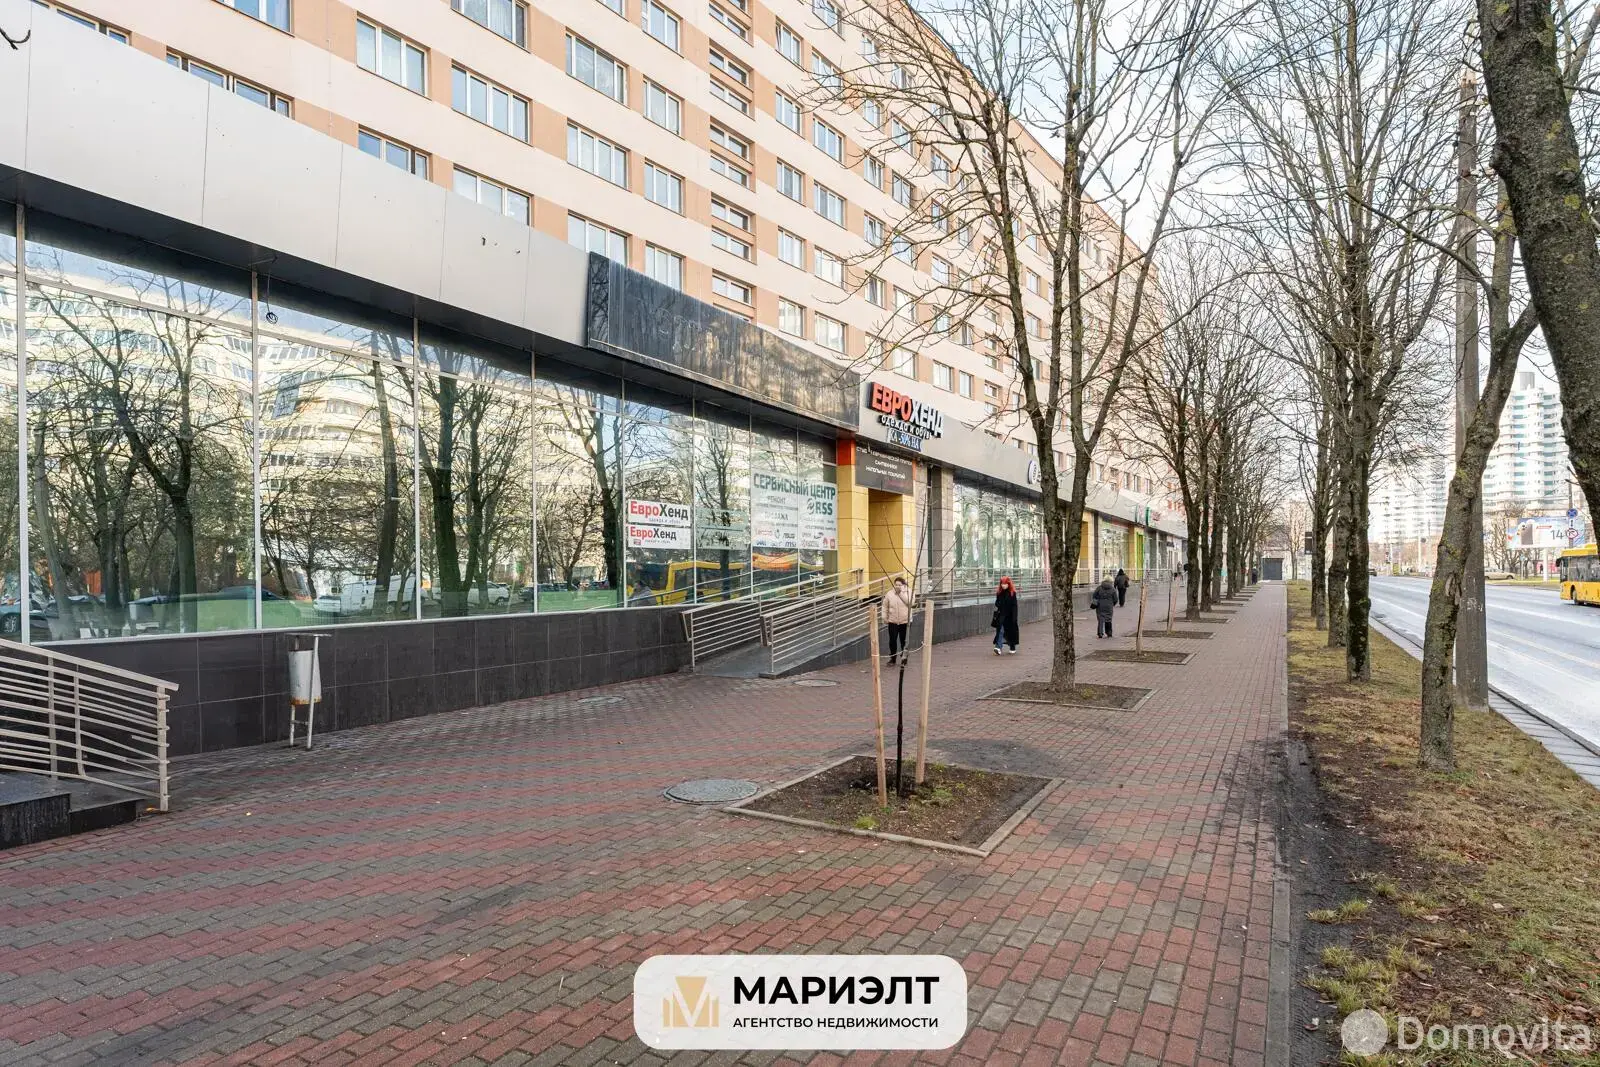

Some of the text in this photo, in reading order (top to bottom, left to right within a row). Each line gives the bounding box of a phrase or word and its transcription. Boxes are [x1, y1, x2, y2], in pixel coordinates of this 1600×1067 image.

[868, 381, 944, 438] ЕВРОХЕНД
[753, 472, 837, 501] СЕРВИСНЫЙ ЦЕНТР
[630, 500, 689, 521] ЕвроХенд
[815, 501, 834, 516] RSS
[629, 526, 677, 542] ЕвроХенд
